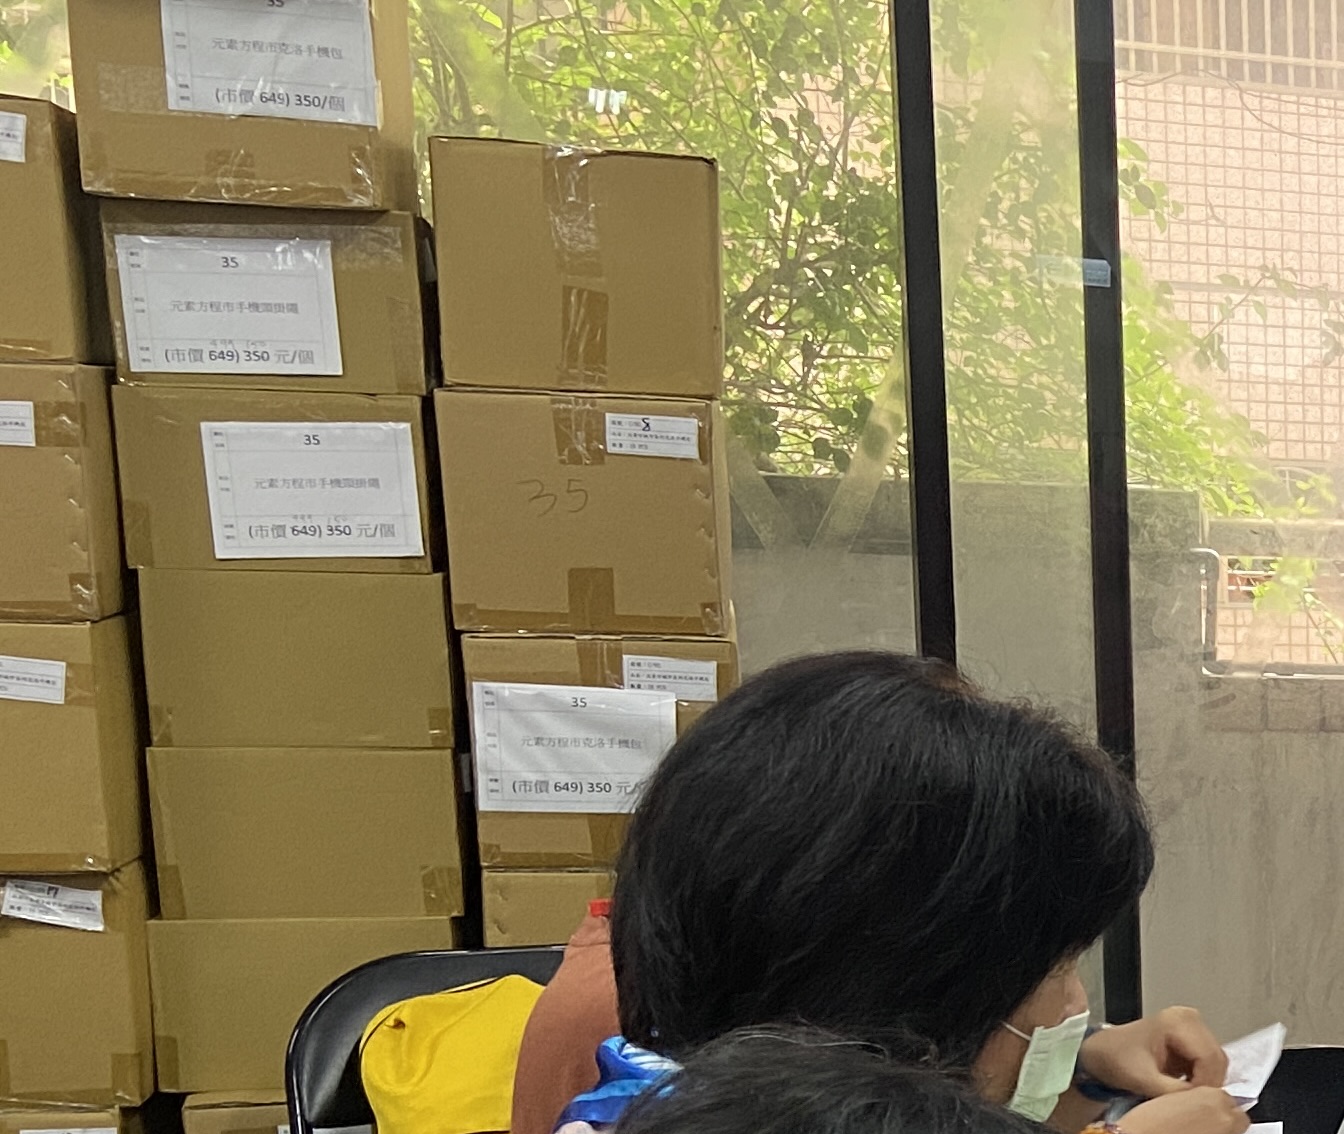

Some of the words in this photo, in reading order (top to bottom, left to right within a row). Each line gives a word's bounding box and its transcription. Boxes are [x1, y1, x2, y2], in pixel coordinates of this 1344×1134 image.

[221, 256, 240, 269] 35
[208, 349, 240, 364] 649)
[244, 350, 270, 362] 350
[303, 434, 322, 446] 35
[515, 478, 589, 518] 35
[291, 524, 323, 539] 649)
[326, 524, 352, 536] 350
[570, 697, 588, 709] 35
[553, 782, 584, 795] 649)
[587, 782, 613, 794] 350
